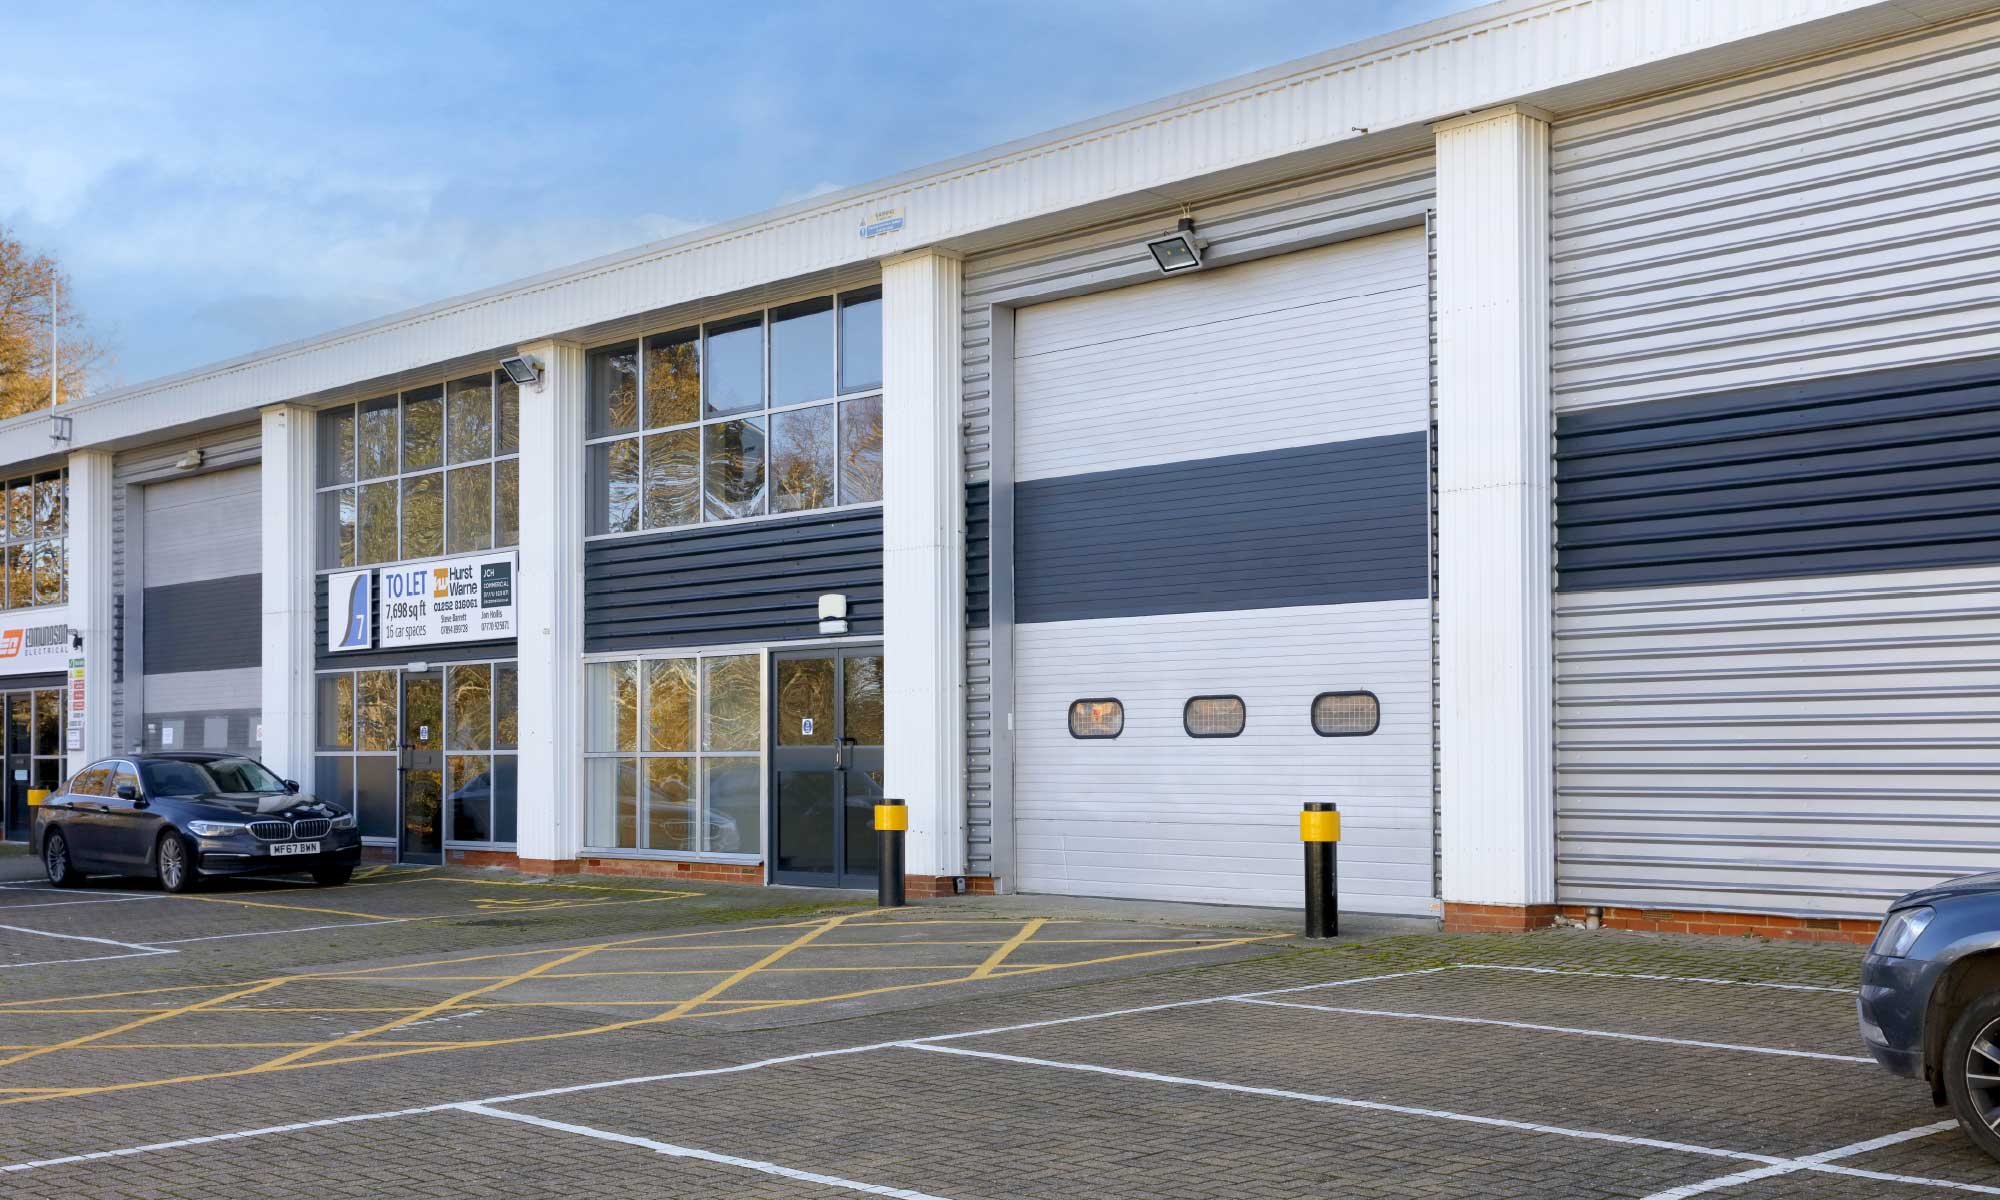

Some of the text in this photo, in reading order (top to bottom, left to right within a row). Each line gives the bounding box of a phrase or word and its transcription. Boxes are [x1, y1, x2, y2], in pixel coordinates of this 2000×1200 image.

[449, 564, 473, 580] Hurst
[483, 568, 495, 578] JCH
[386, 570, 427, 599] TO LET
[449, 581, 477, 597] Warne
[386, 599, 427, 622] 7,698 sq ft
[433, 600, 454, 612] 01252
[455, 598, 478, 610] 816061
[355, 614, 365, 640] 7
[386, 624, 427, 640] 16 car spaces
[25, 624, 68, 648] EDMUNDSON
[25, 646, 69, 656] ELECTRICAL
